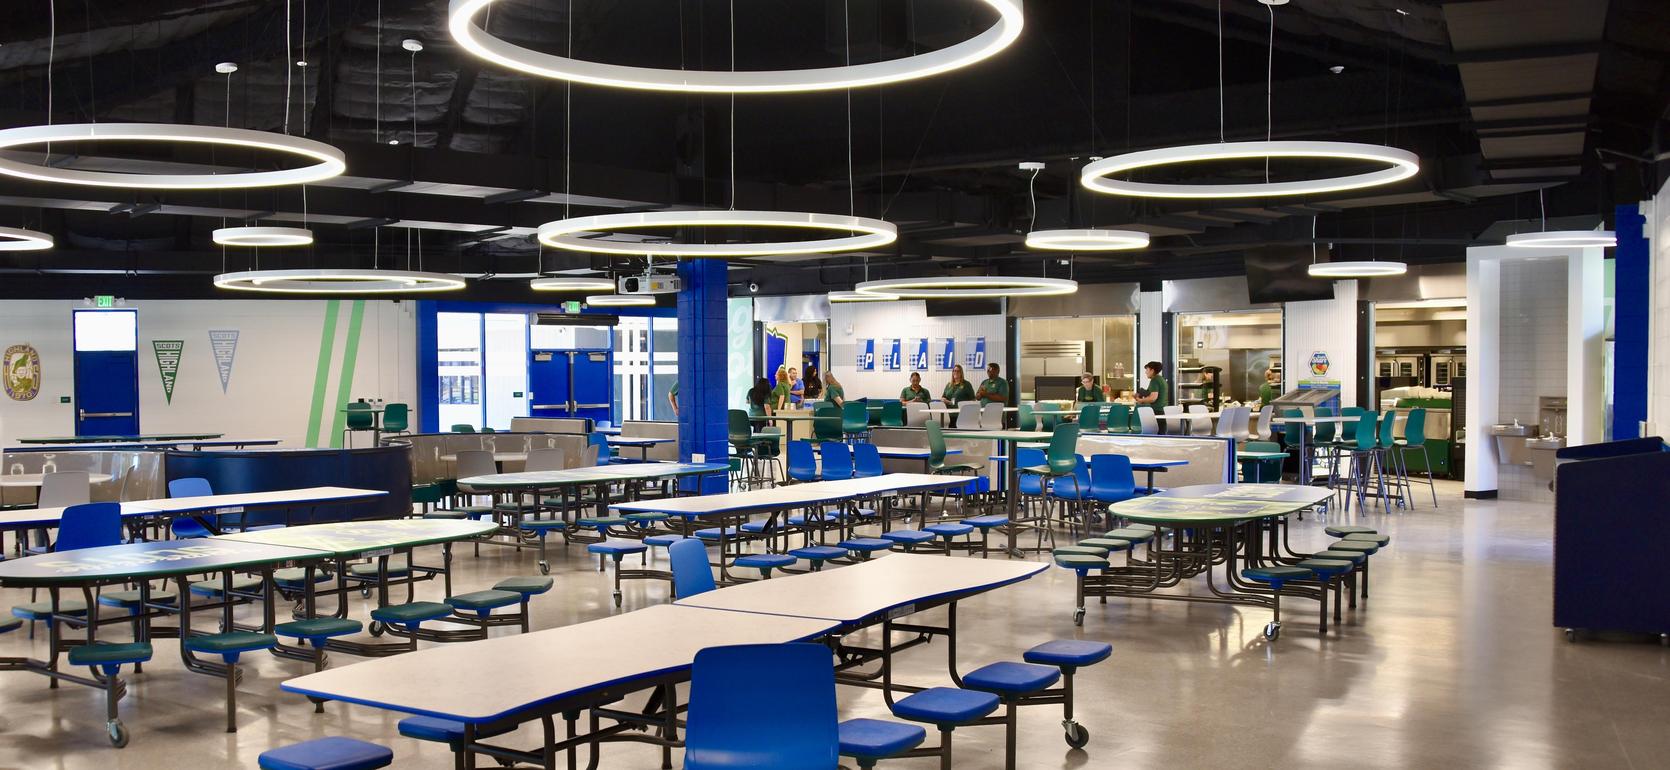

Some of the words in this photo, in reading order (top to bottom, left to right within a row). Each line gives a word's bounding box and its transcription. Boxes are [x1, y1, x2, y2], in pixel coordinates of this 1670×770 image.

[97, 296, 112, 307] EXIT
[157, 351, 180, 393] HIGHLAND
[213, 341, 235, 382] HIGHLAND
